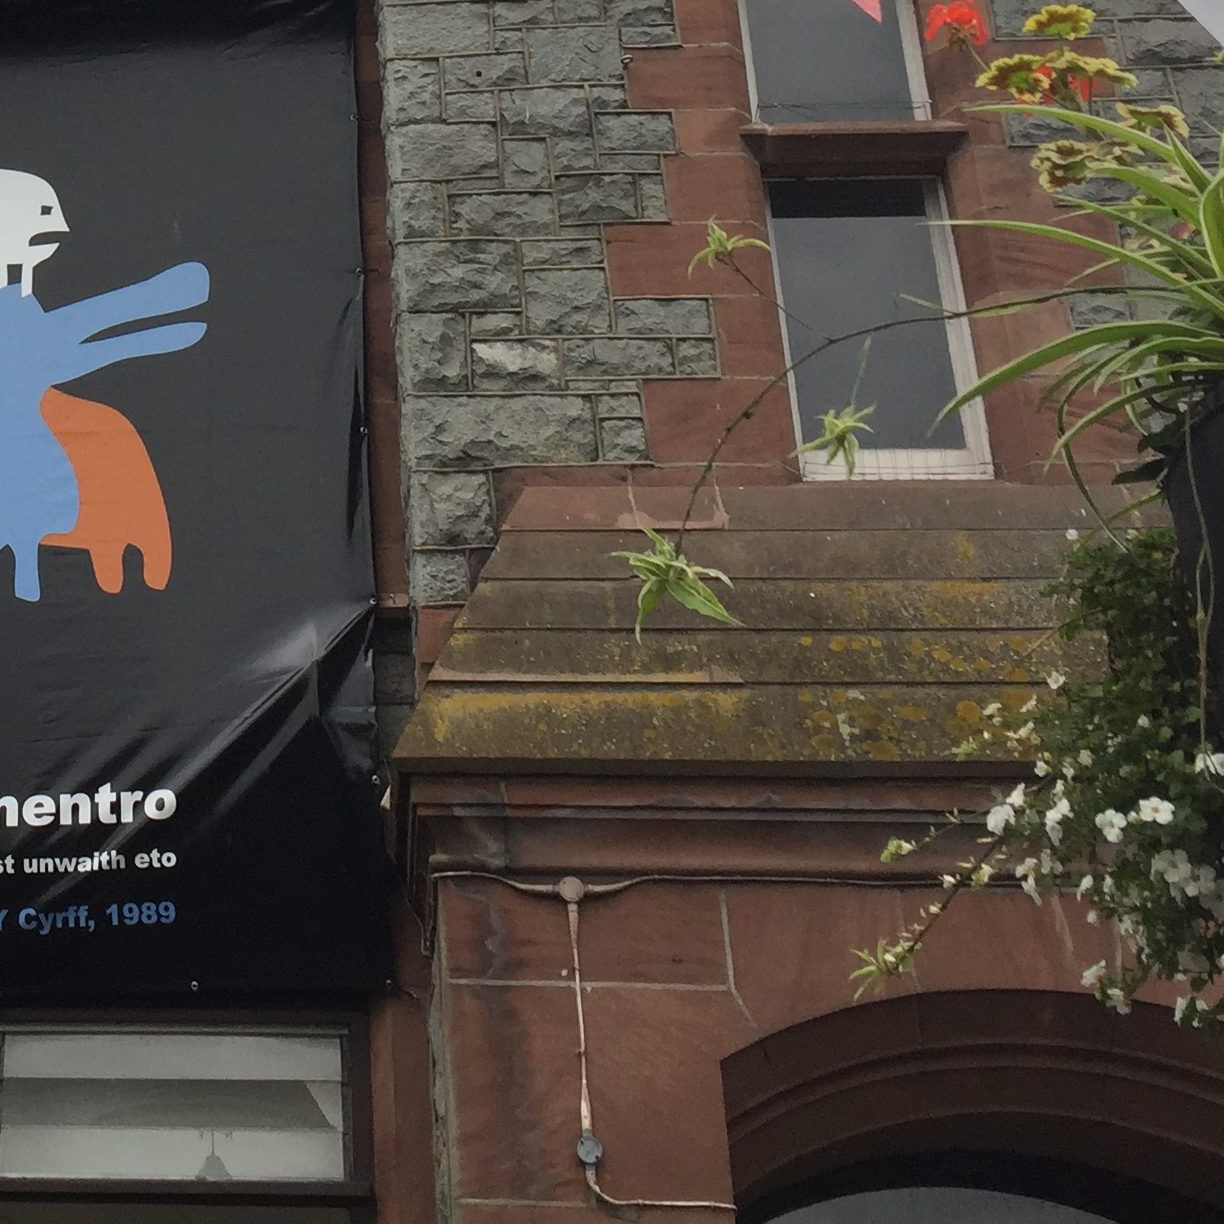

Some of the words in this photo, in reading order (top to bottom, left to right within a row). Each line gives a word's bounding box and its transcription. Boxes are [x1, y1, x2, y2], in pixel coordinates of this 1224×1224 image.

[23, 851, 126, 874] unwaith
[134, 848, 177, 869] eto
[18, 905, 96, 935] Cyrff,
[106, 901, 176, 926] 1989
